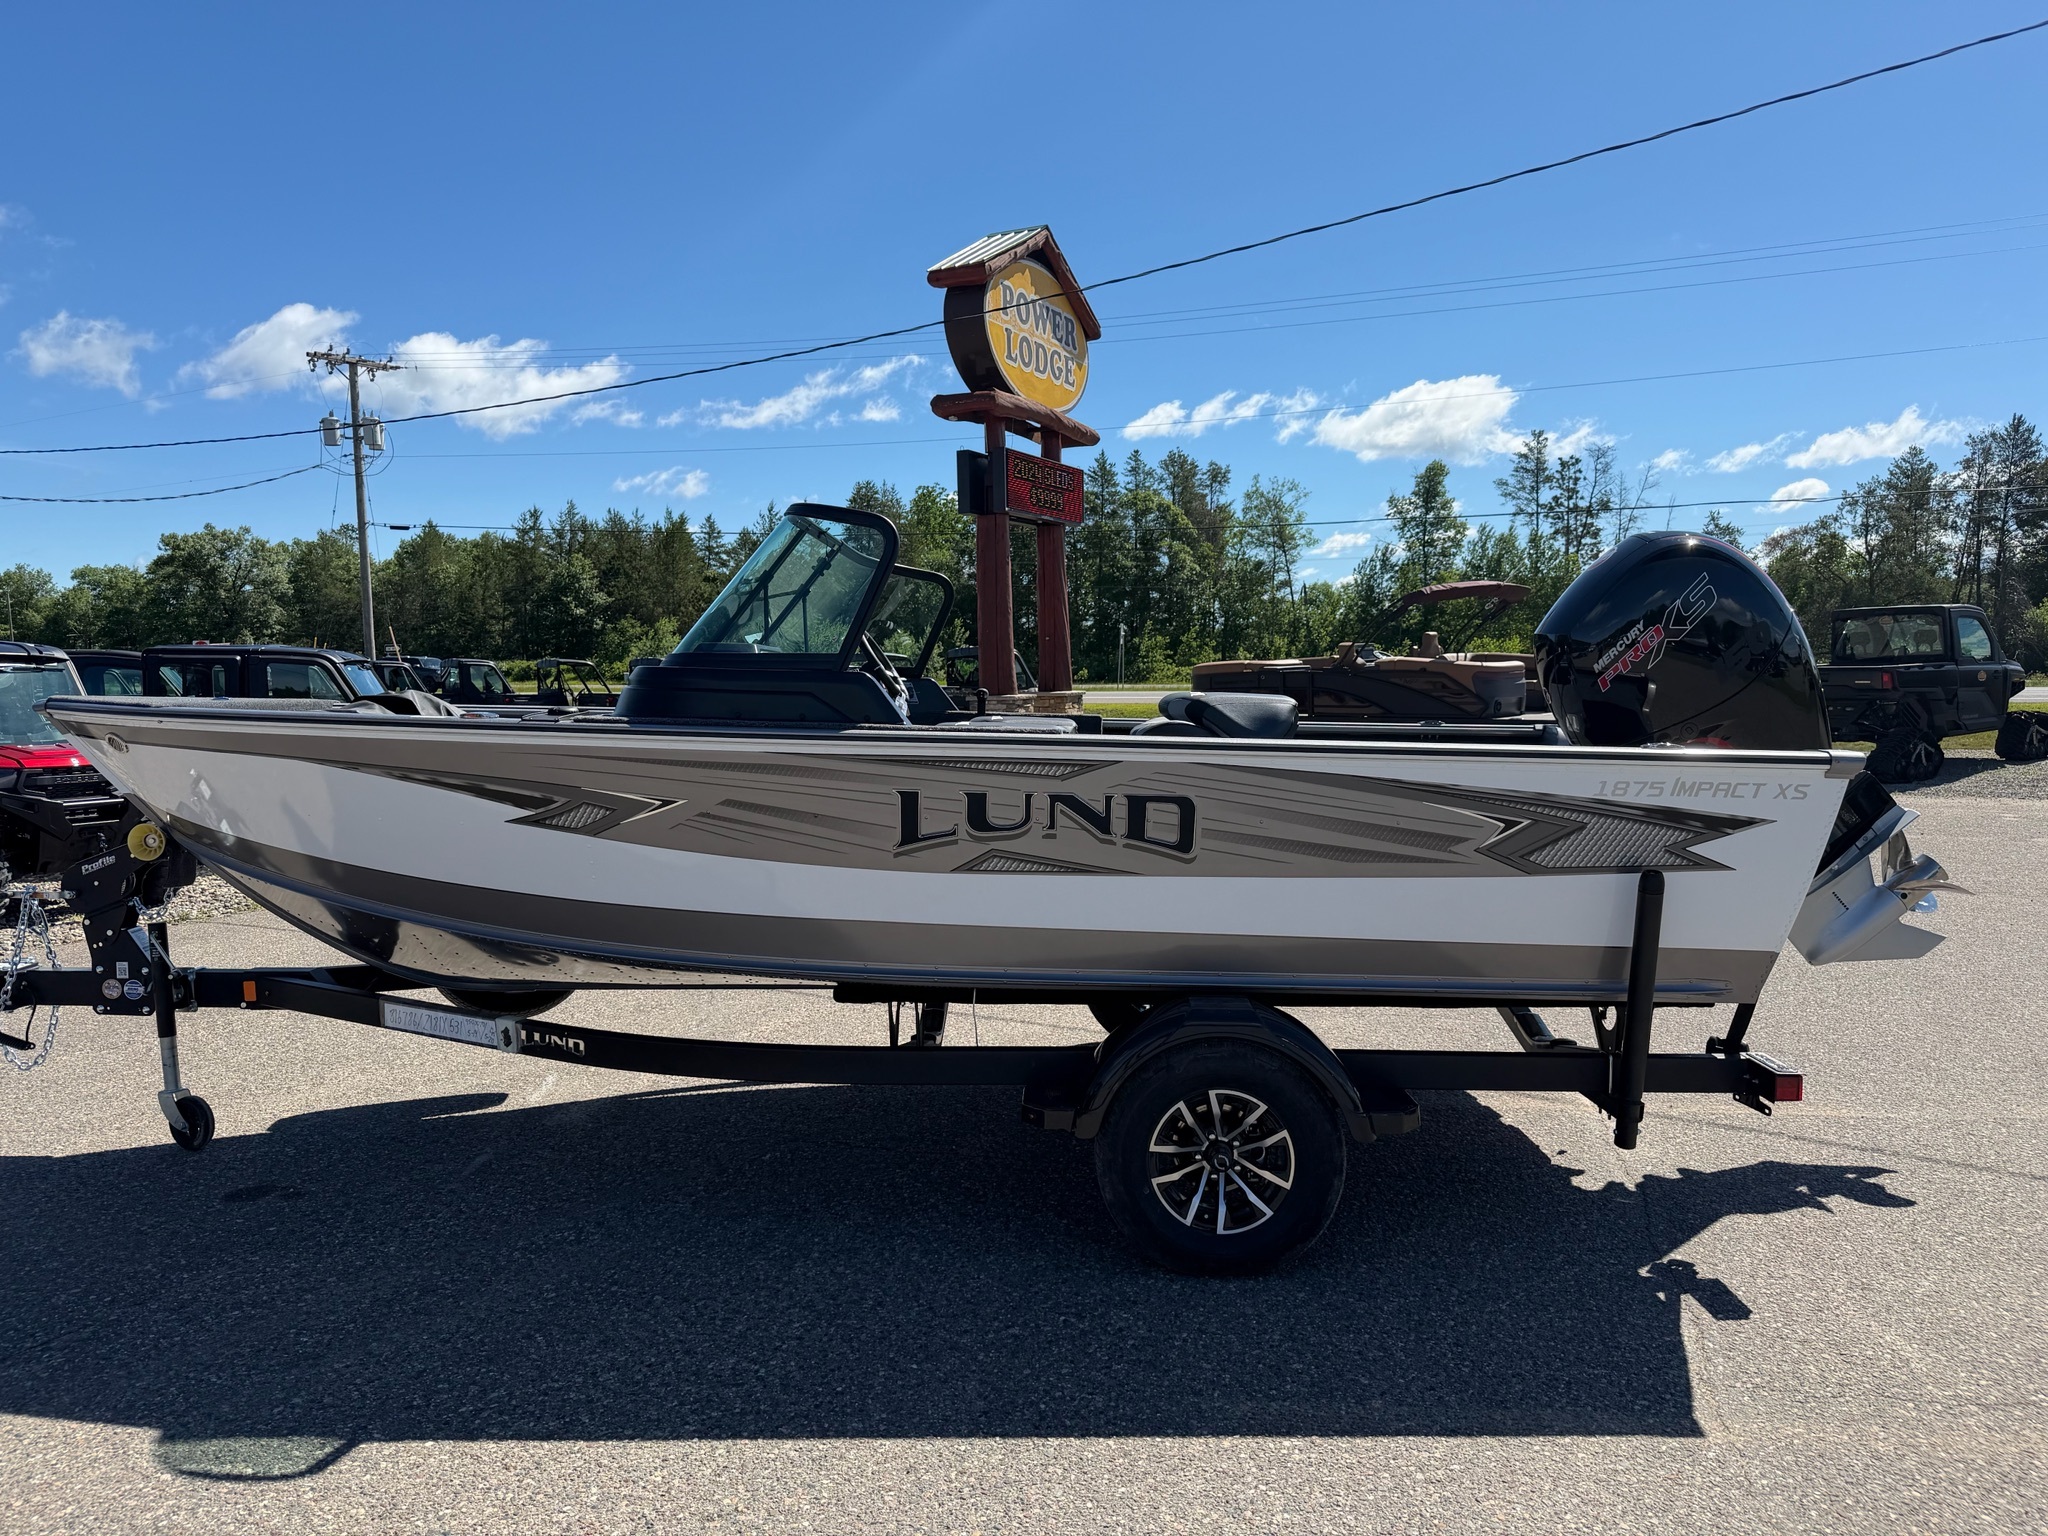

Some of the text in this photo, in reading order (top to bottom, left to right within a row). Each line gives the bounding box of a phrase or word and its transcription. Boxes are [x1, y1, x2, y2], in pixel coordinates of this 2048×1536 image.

[1000, 280, 1078, 352] POWER
[1004, 326, 1077, 390] LODGE
[1593, 620, 1645, 673] MERCURY
[1593, 776, 1811, 800] 1875 IMPACT XS
[893, 789, 1197, 858] LUND
[81, 855, 116, 873] Profile
[520, 1030, 585, 1057] LUND
